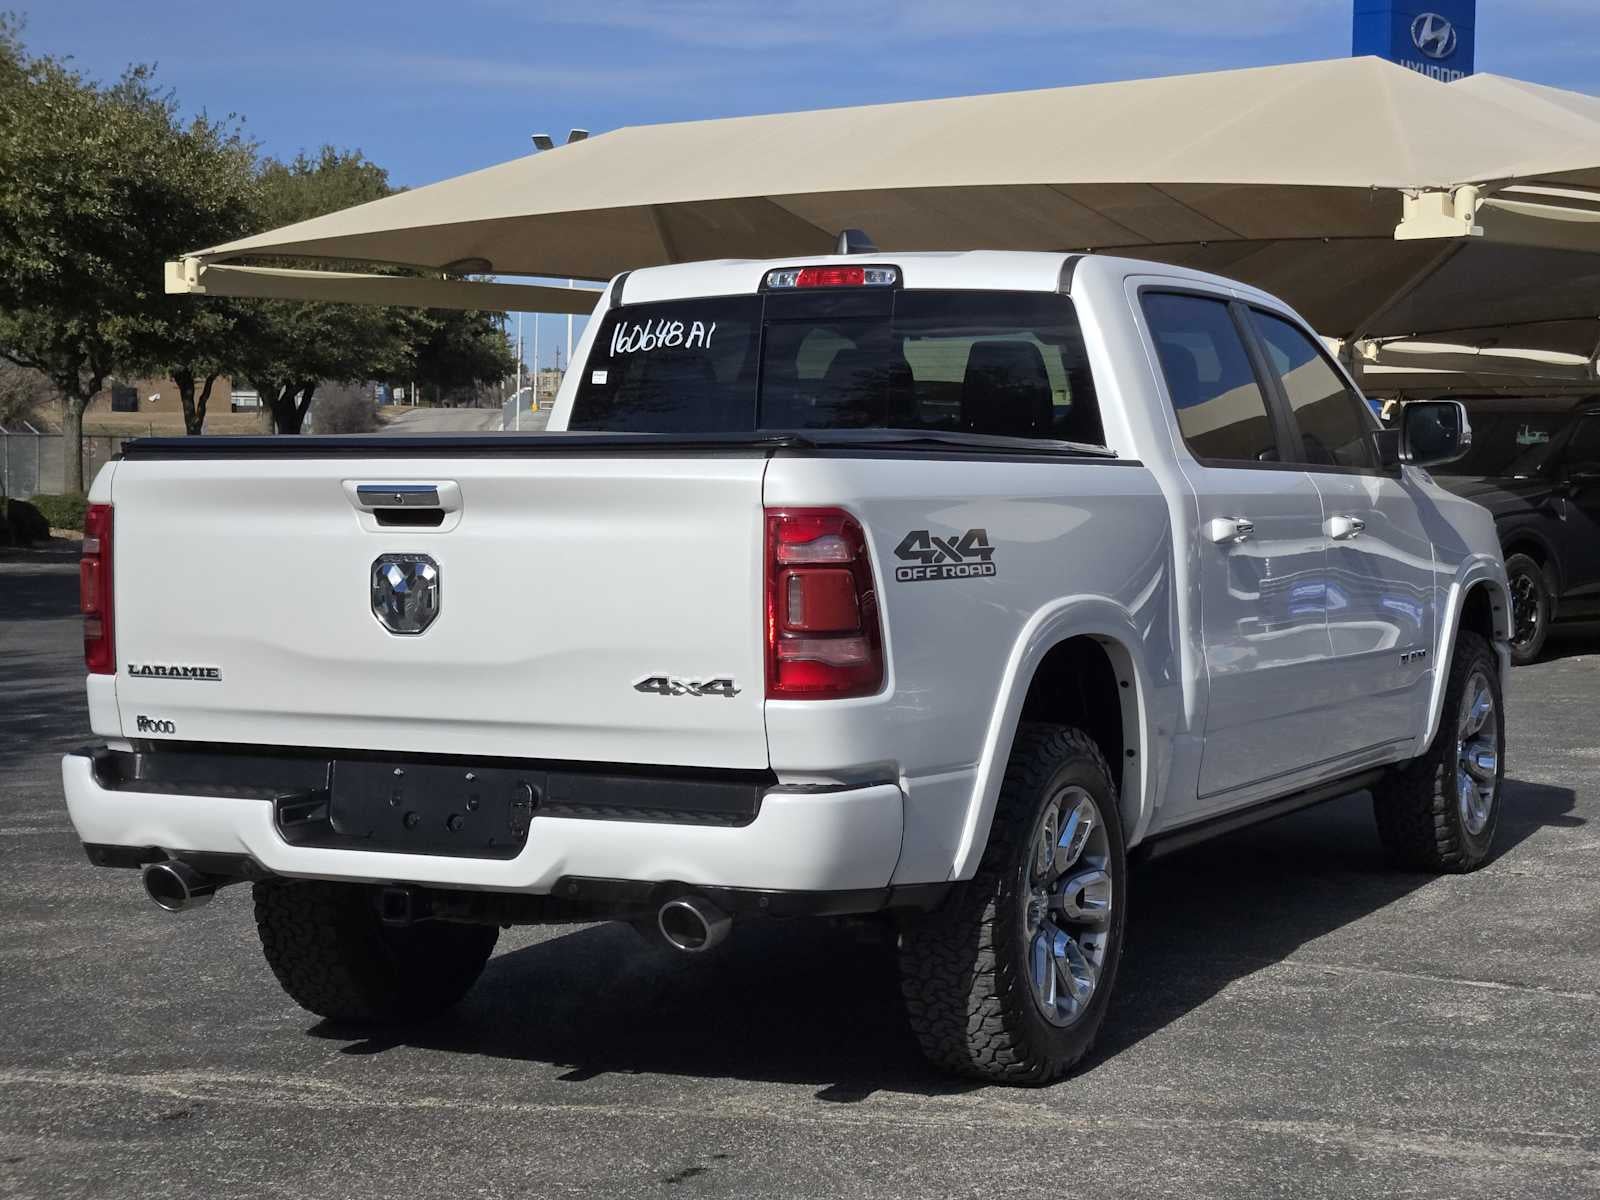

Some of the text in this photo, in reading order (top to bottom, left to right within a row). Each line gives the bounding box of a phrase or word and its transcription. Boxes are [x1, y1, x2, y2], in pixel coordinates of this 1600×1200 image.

[897, 564, 994, 580] OFF ROAD
[128, 664, 220, 679] LARAMIE
